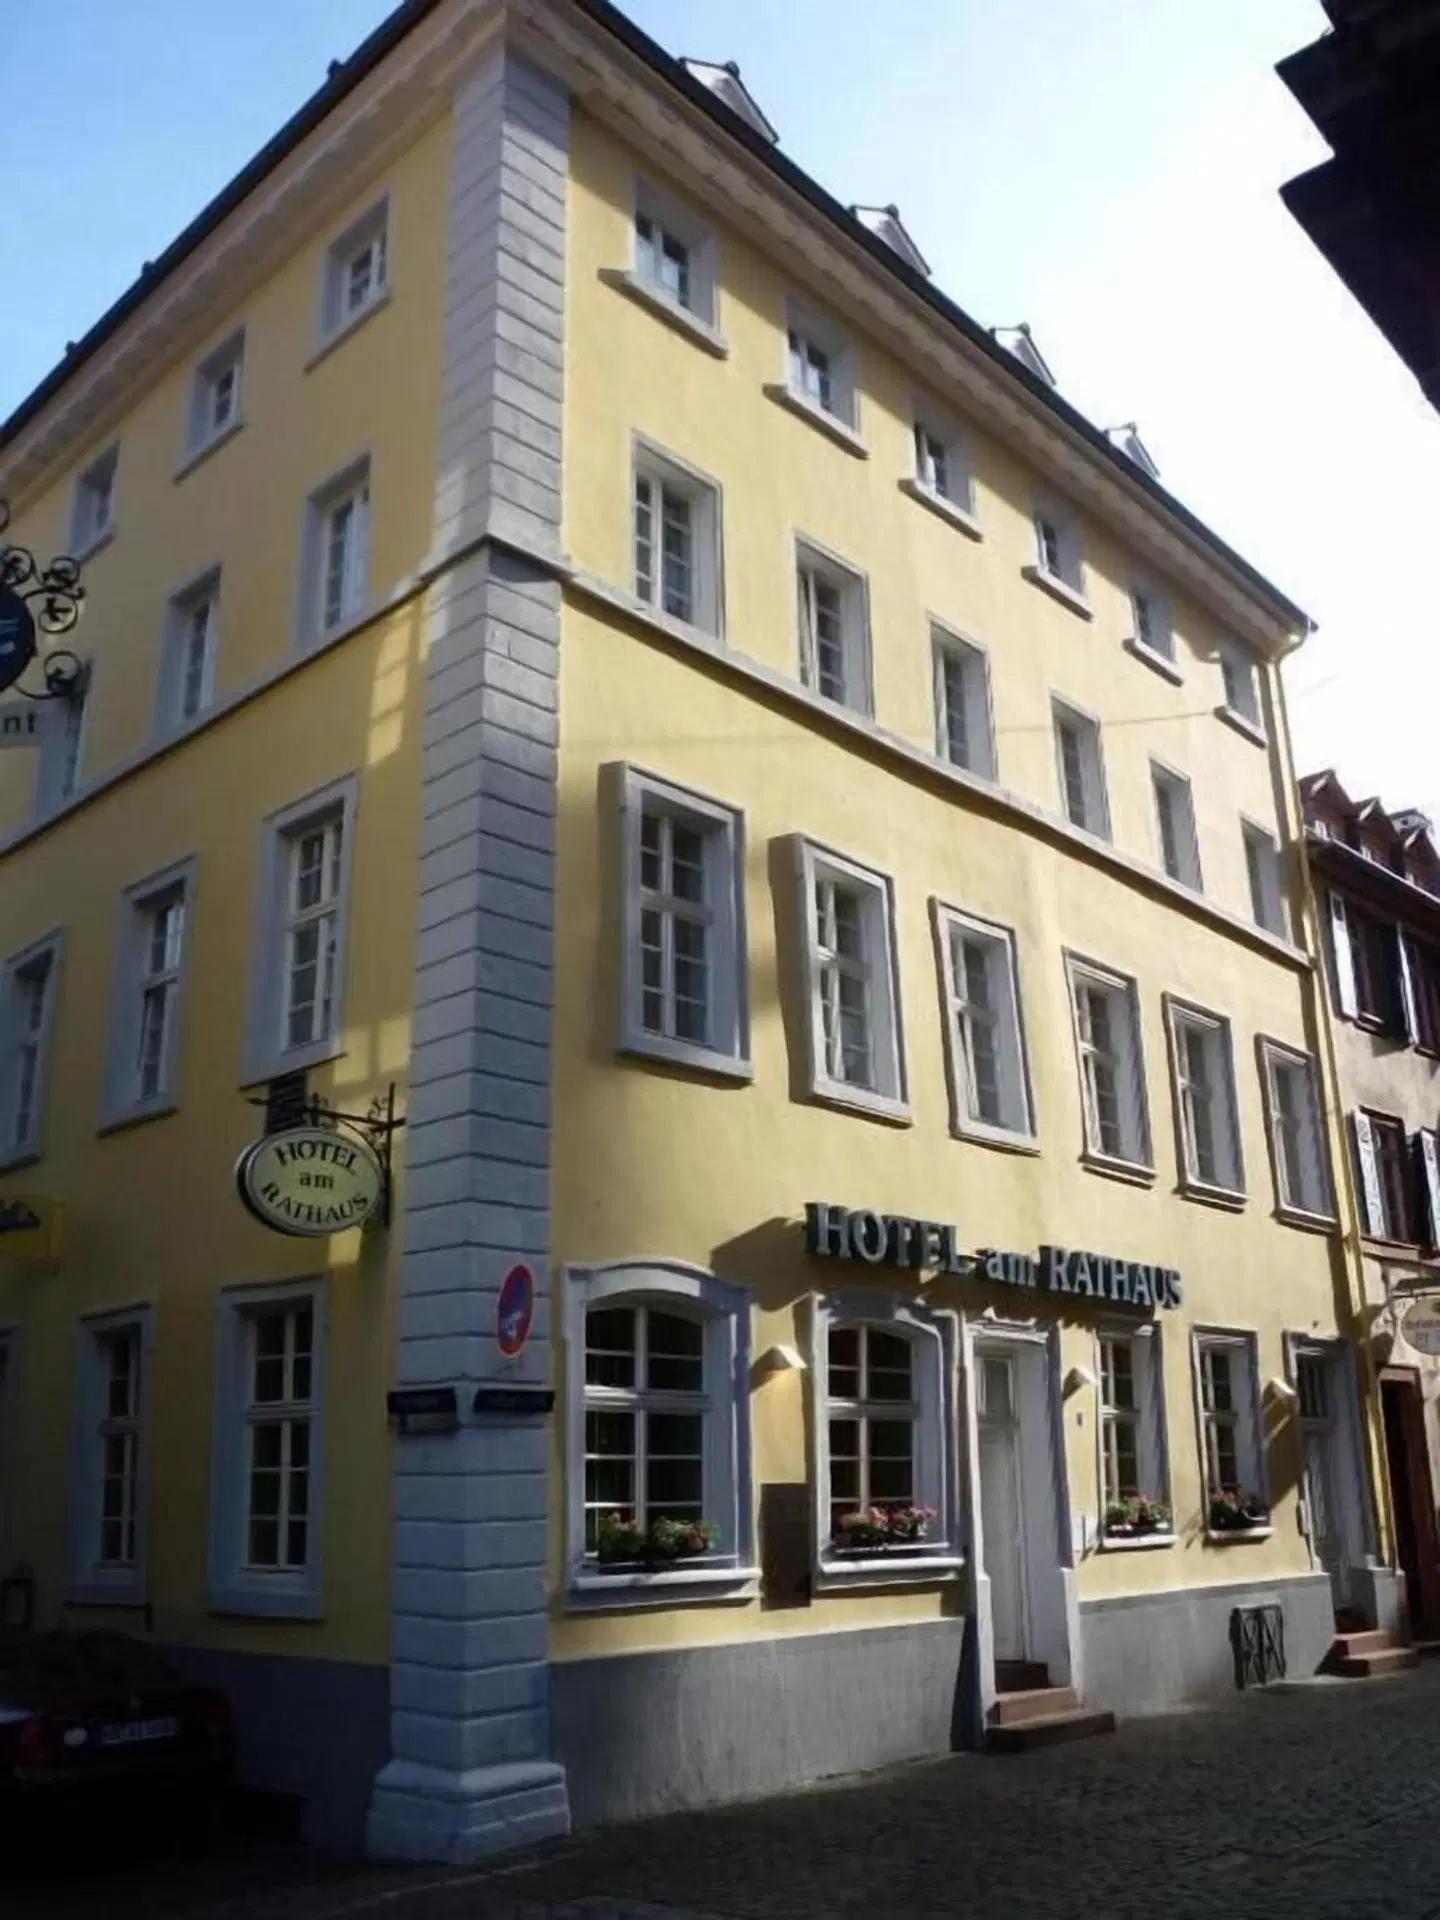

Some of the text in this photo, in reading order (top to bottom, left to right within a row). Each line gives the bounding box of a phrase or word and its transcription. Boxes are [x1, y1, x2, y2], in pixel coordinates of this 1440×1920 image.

[274, 1140, 357, 1176] HOTEL
[299, 1172, 334, 1191] am
[261, 1181, 368, 1223] RATHAUS
[808, 1201, 1182, 1310] HOTEL am RATHAUS
